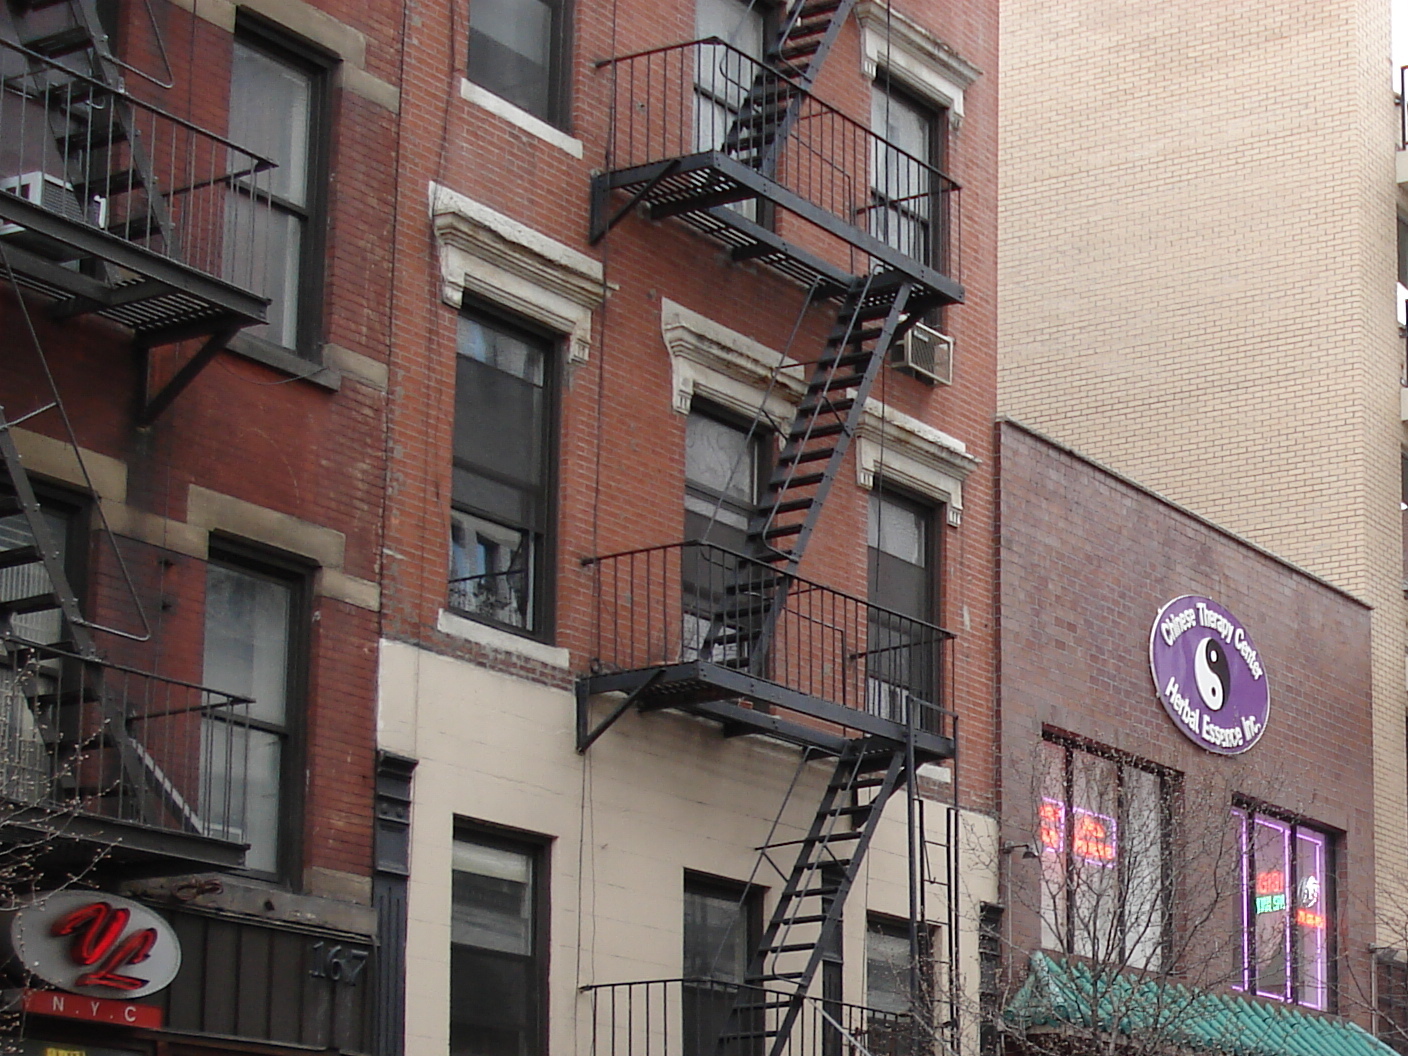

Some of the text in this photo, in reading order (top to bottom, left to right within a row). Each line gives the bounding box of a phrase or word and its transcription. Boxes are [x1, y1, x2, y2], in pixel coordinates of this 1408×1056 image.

[1160, 602, 1264, 681] Chinese Therapy Center
[1165, 676, 1200, 734] Herbal
[1201, 714, 1244, 748] Essence
[308, 940, 369, 986] 167
